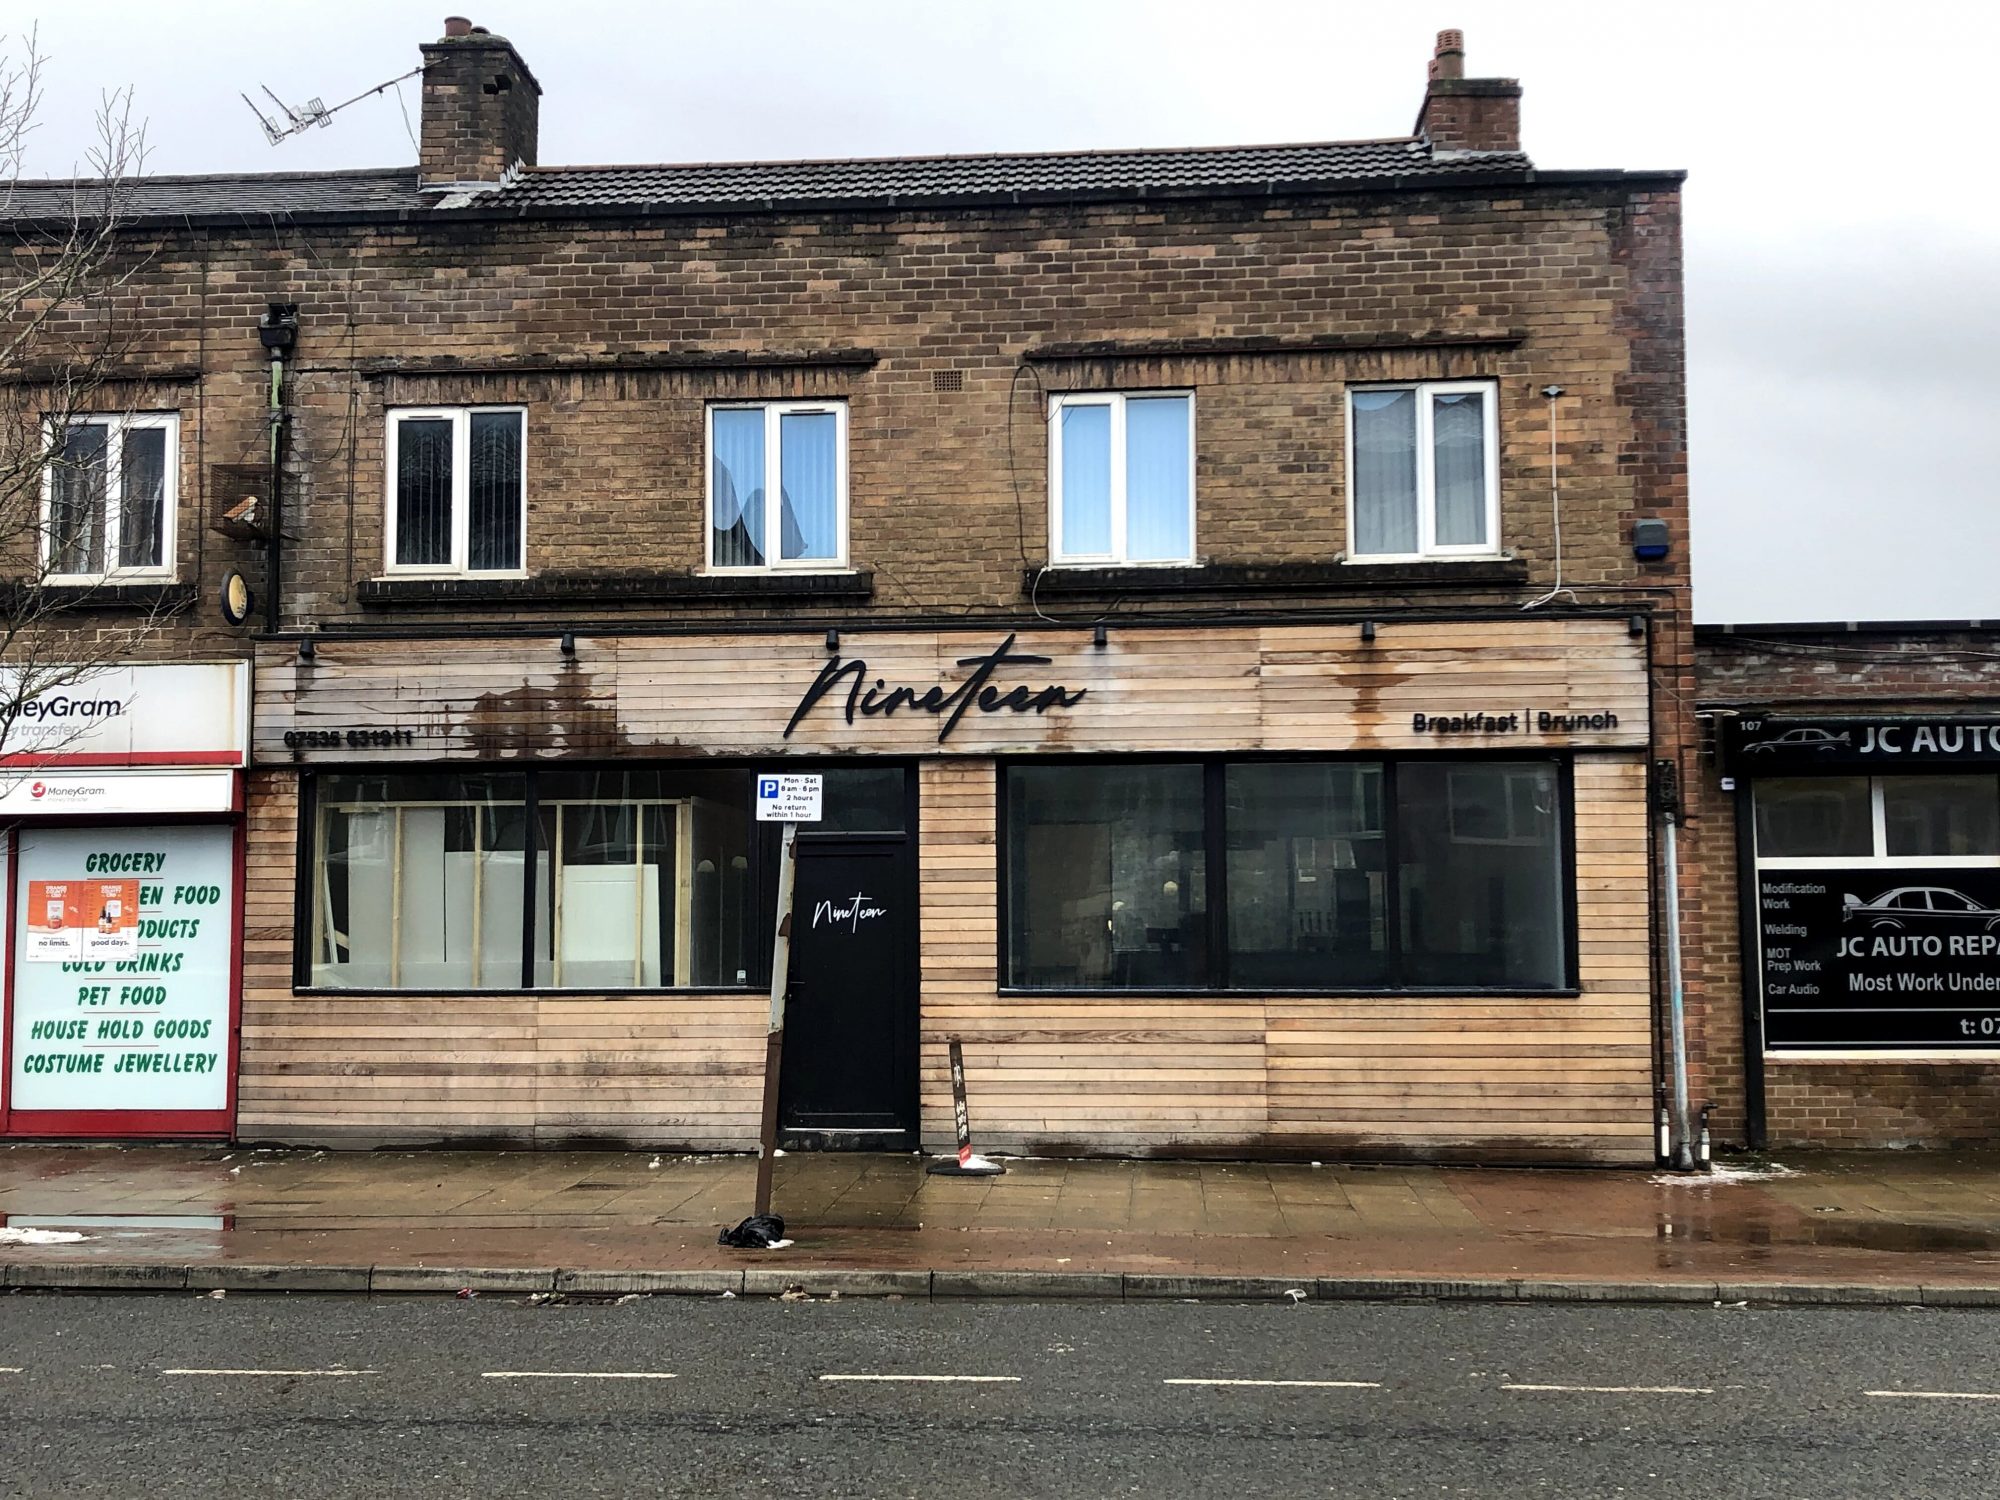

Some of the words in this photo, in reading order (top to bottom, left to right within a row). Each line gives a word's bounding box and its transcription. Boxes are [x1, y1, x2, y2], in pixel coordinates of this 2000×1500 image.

[783, 633, 1087, 744] Nineteen
[0, 696, 121, 722] neyGram
[1413, 712, 1518, 732] Breakfast
[1538, 711, 1618, 731] Brunch
[1740, 721, 1762, 731] 107
[1860, 726, 1902, 753] JC
[47, 787, 105, 797] MoneyGram
[86, 853, 166, 873] GROCERY
[139, 886, 164, 905] EN
[174, 886, 220, 905] FOOD
[1762, 883, 1826, 894] Modification
[812, 891, 887, 934] Nineteen
[1763, 899, 1790, 909] Work
[138, 919, 200, 938] ODUCTS
[1765, 924, 1807, 937] Welding
[1767, 948, 1791, 959] MOT
[1836, 937, 1865, 957] JC
[1871, 936, 1942, 957] AUTO
[1949, 935, 2000, 956] REP
[1767, 961, 1791, 973] Prep
[1794, 961, 1821, 971] Work
[1768, 984, 1786, 994] Car
[1789, 984, 1819, 994] Audio
[1849, 973, 1893, 991] Most
[1897, 973, 1944, 991] Work
[78, 986, 110, 1006] PET
[120, 986, 167, 1005] FOOD
[31, 1020, 89, 1039] HOUSE
[97, 1020, 143, 1039] HOLD
[153, 1019, 212, 1039] GOODS
[23, 1054, 104, 1074] COSTUME
[113, 1053, 218, 1074] JEWELLERY
